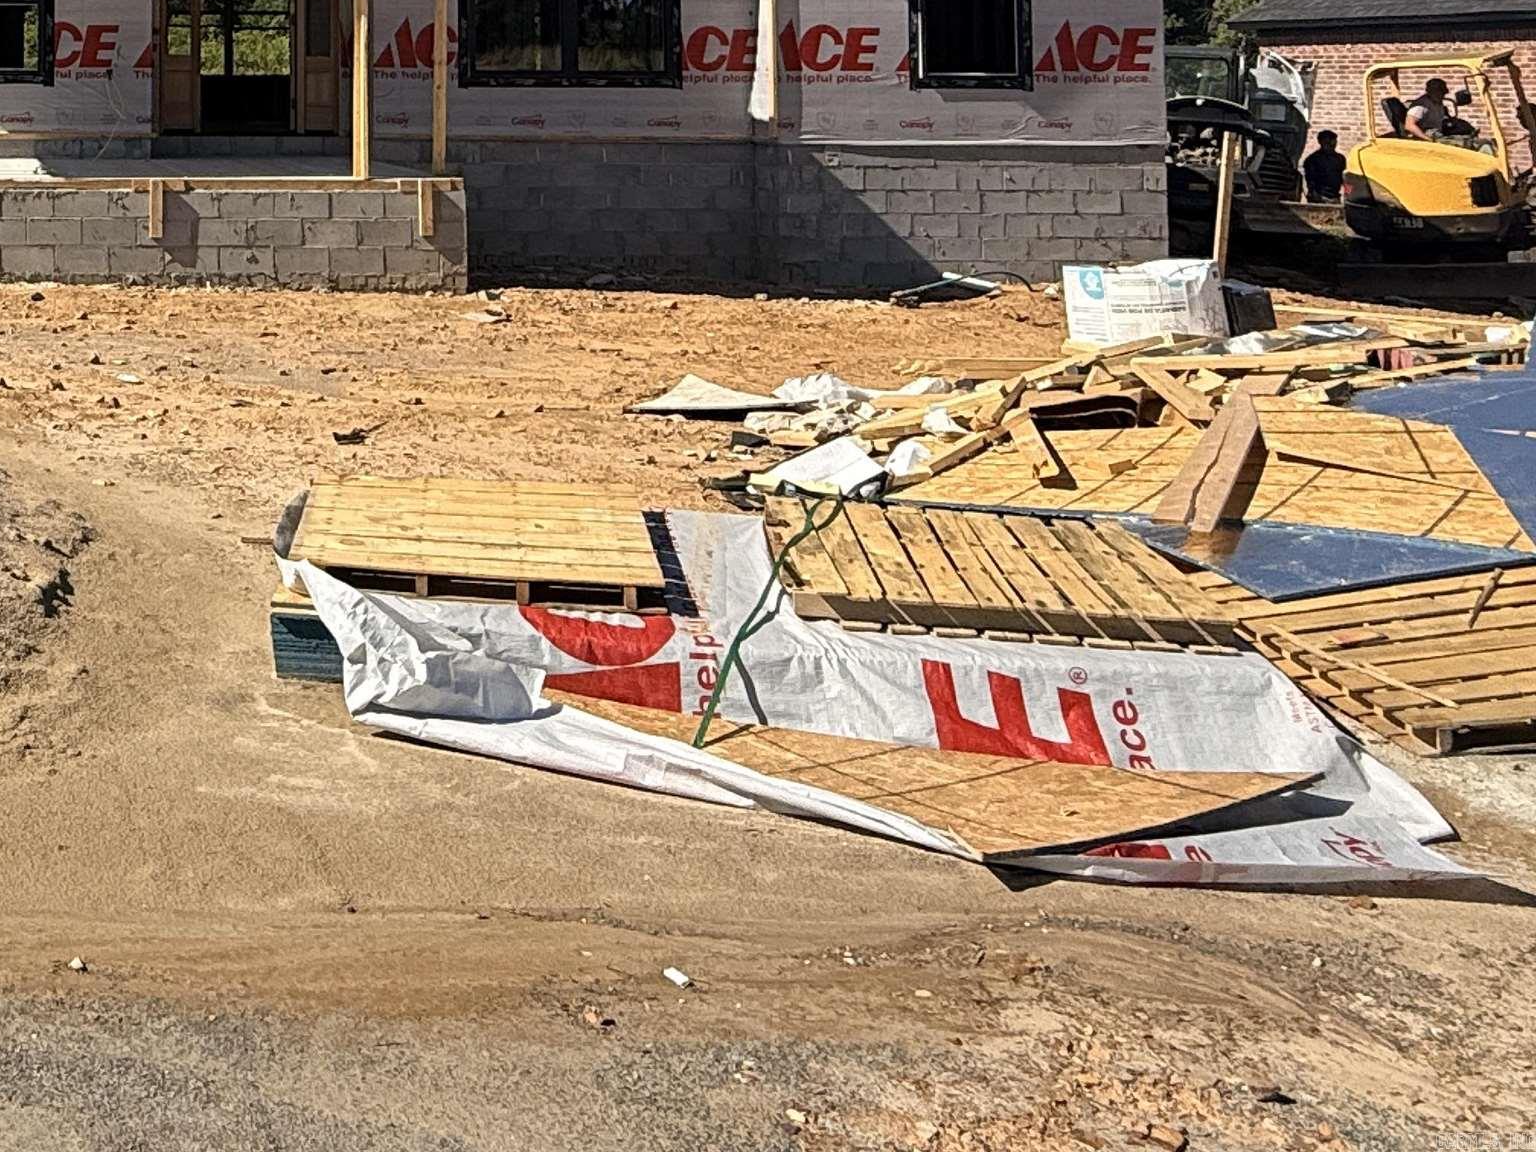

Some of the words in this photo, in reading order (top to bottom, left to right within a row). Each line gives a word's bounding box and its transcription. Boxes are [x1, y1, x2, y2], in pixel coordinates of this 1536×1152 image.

[55, 21, 120, 68] CE
[680, 24, 758, 72] CE
[1034, 20, 1156, 72] ACE
[786, 74, 833, 85] helpful
[1035, 73, 1058, 84] The
[1064, 73, 1110, 85] helpful
